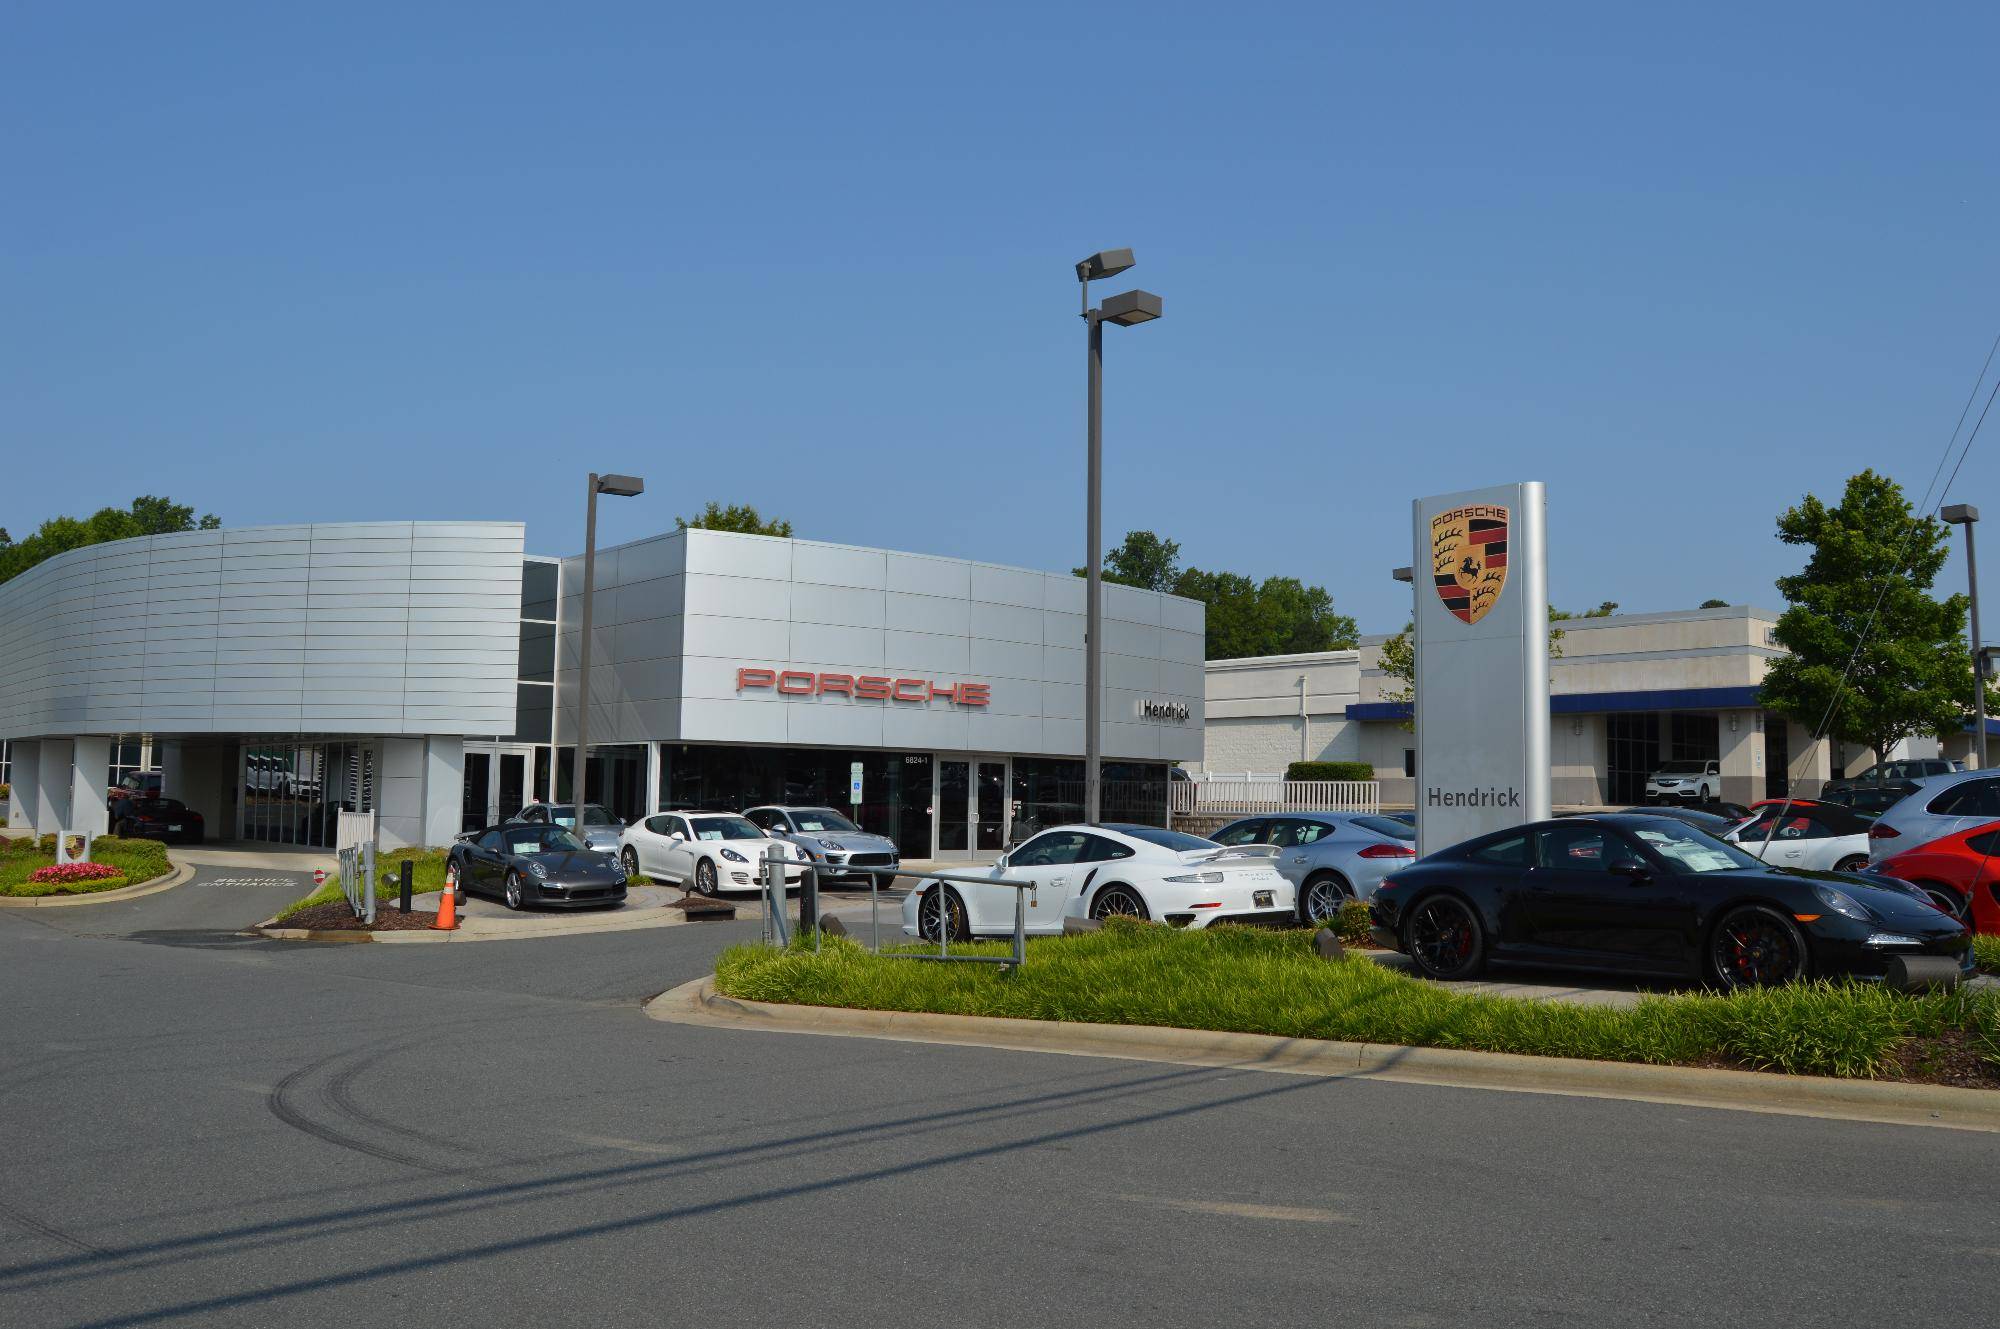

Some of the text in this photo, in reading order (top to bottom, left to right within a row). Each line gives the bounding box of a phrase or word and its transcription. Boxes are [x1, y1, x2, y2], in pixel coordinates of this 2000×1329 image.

[1433, 507, 1506, 529] PORSCHE
[735, 668, 991, 706] PORSCHE
[1144, 699, 1190, 719] Hendrick
[905, 756, 928, 764] 6824-1
[1428, 787, 1520, 807] Hendrick
